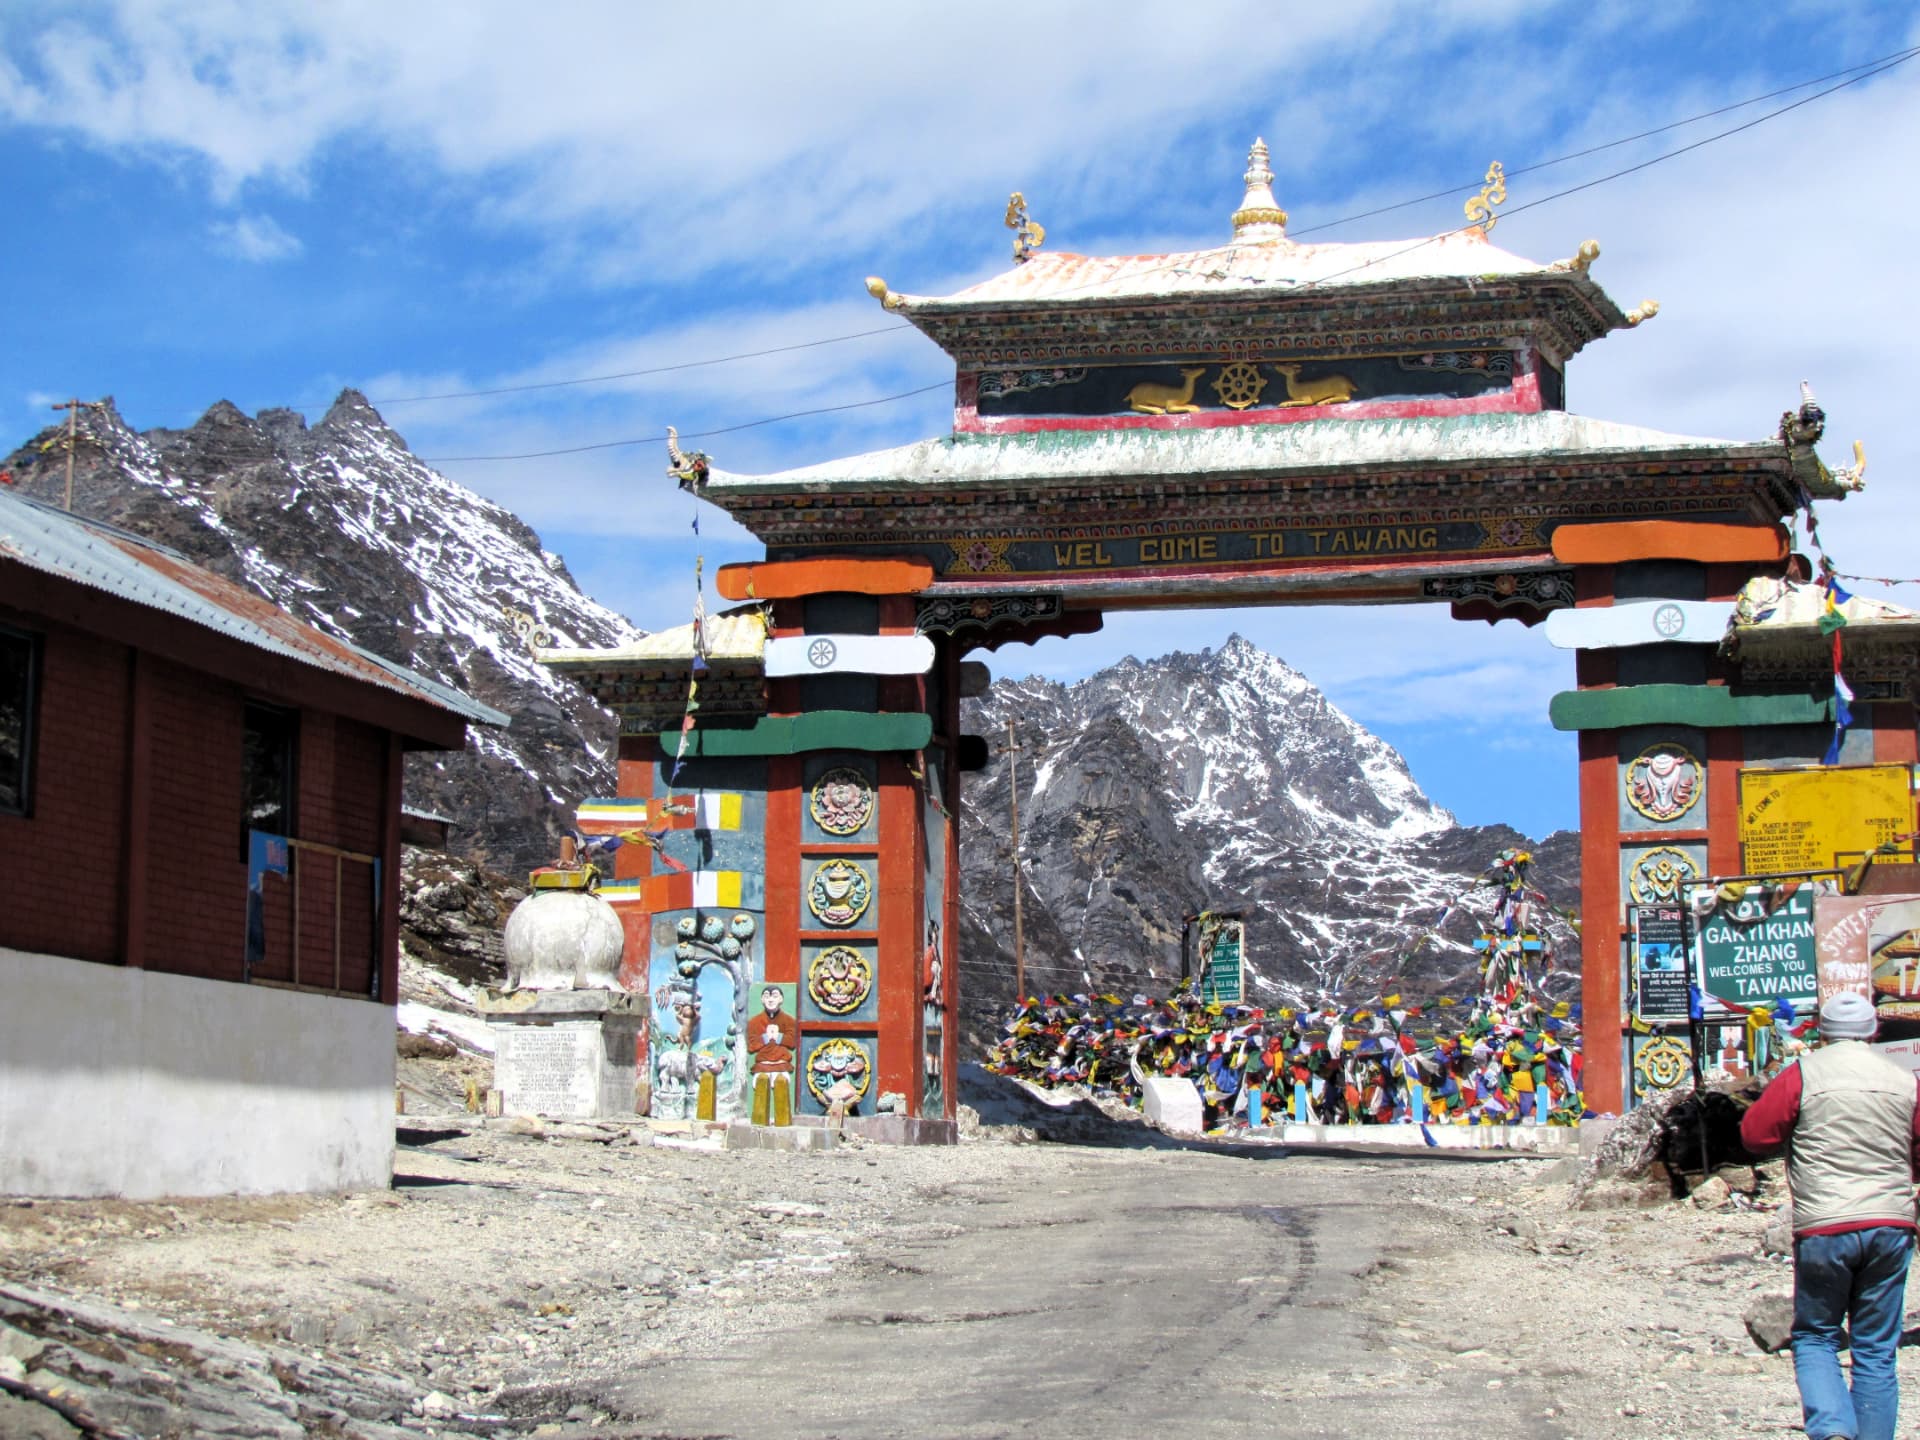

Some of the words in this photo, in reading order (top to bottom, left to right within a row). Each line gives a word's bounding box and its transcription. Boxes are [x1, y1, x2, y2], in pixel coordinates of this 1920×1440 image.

[1054, 543, 1112, 567] WEL
[1139, 536, 1217, 562] COME
[1248, 533, 1284, 556] TO
[1308, 527, 1438, 552] TAWANG
[1733, 943, 1797, 963] ZHANG
[1709, 963, 1773, 977] WELCOMES
[1782, 960, 1806, 972] YOU
[1736, 974, 1817, 996] TAWANG
